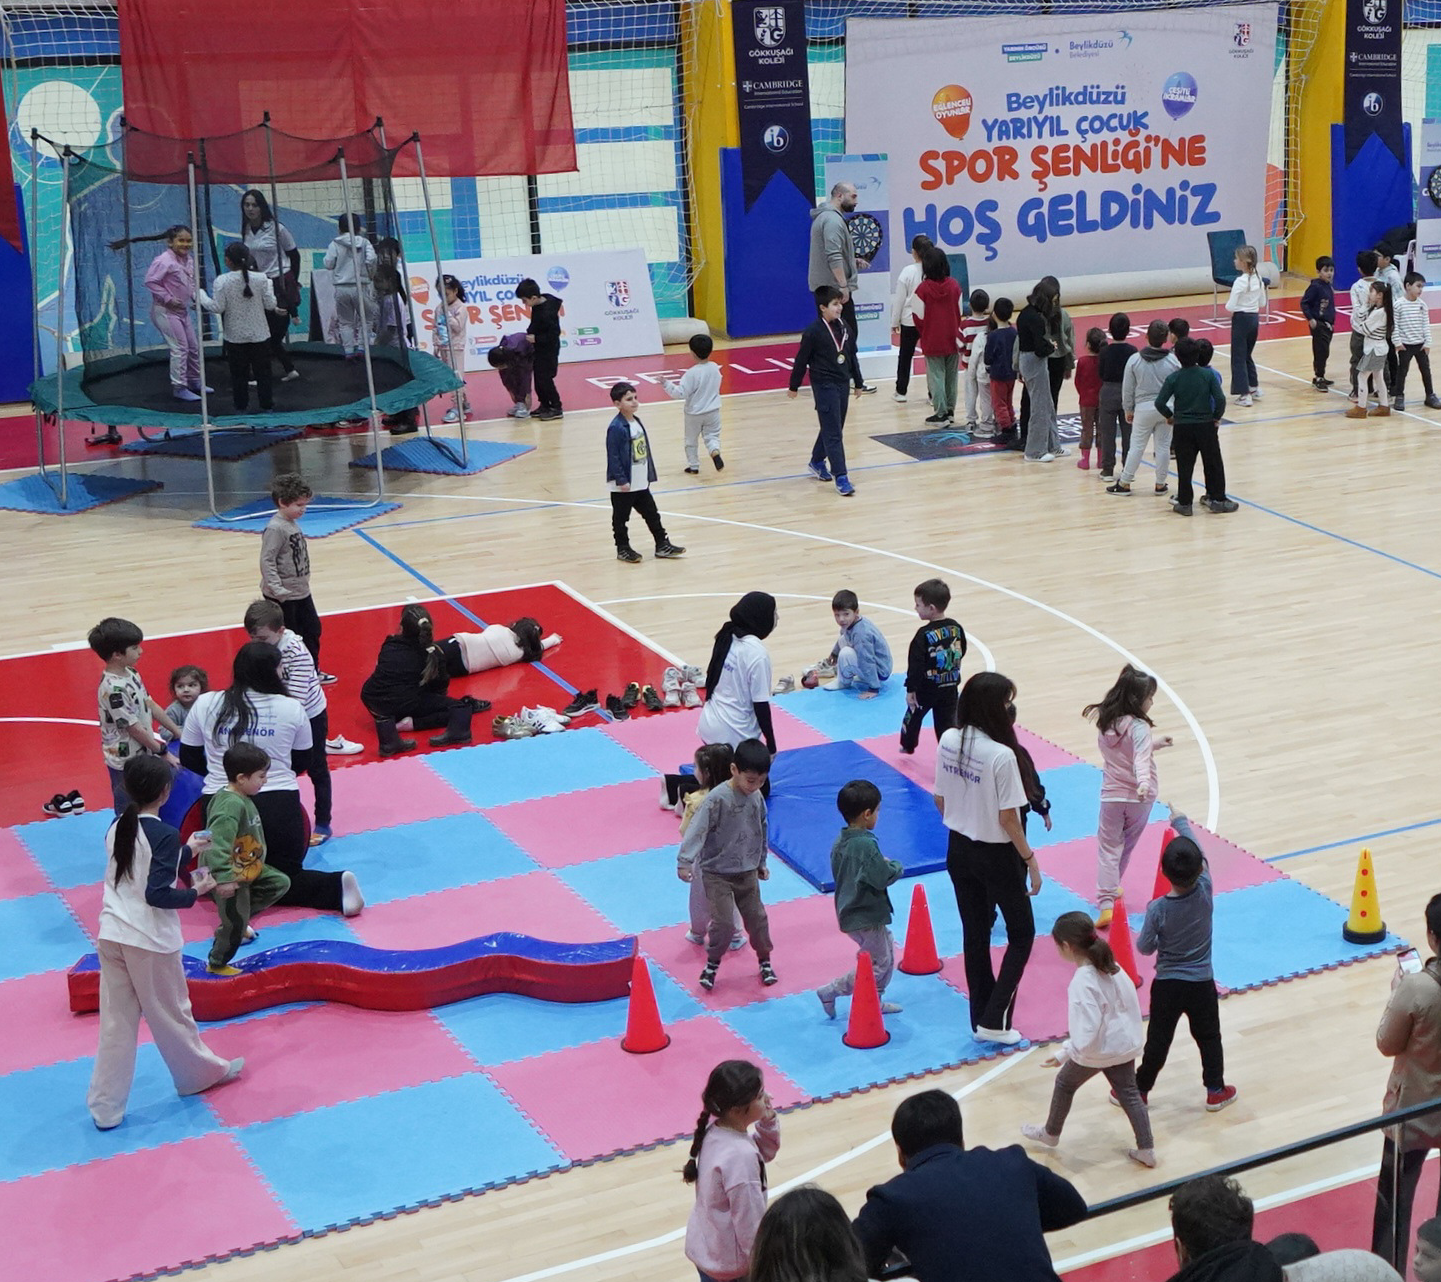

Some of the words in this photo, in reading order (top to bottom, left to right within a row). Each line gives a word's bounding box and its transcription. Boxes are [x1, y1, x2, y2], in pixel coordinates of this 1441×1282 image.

[1069, 40, 1114, 51] Beylikdüzü
[749, 48, 793, 58] GÖKKUŞAĞI
[759, 56, 785, 64] KOLEJİ
[1358, 53, 1397, 61] CAMBRIDGE
[753, 80, 803, 89] CAMBRIDGE
[1007, 85, 1126, 114] Beylikdüzü
[981, 115, 1069, 142] YARIYIL
[1076, 110, 1149, 142] ÇOCUK
[919, 145, 1019, 191] SPOR
[1031, 128, 1207, 192] ŞENLİĞİ'NE
[903, 199, 1002, 262] HOŞ
[1017, 180, 1221, 243] GELDİNİZ
[460, 274, 524, 292] eylikdüzü
